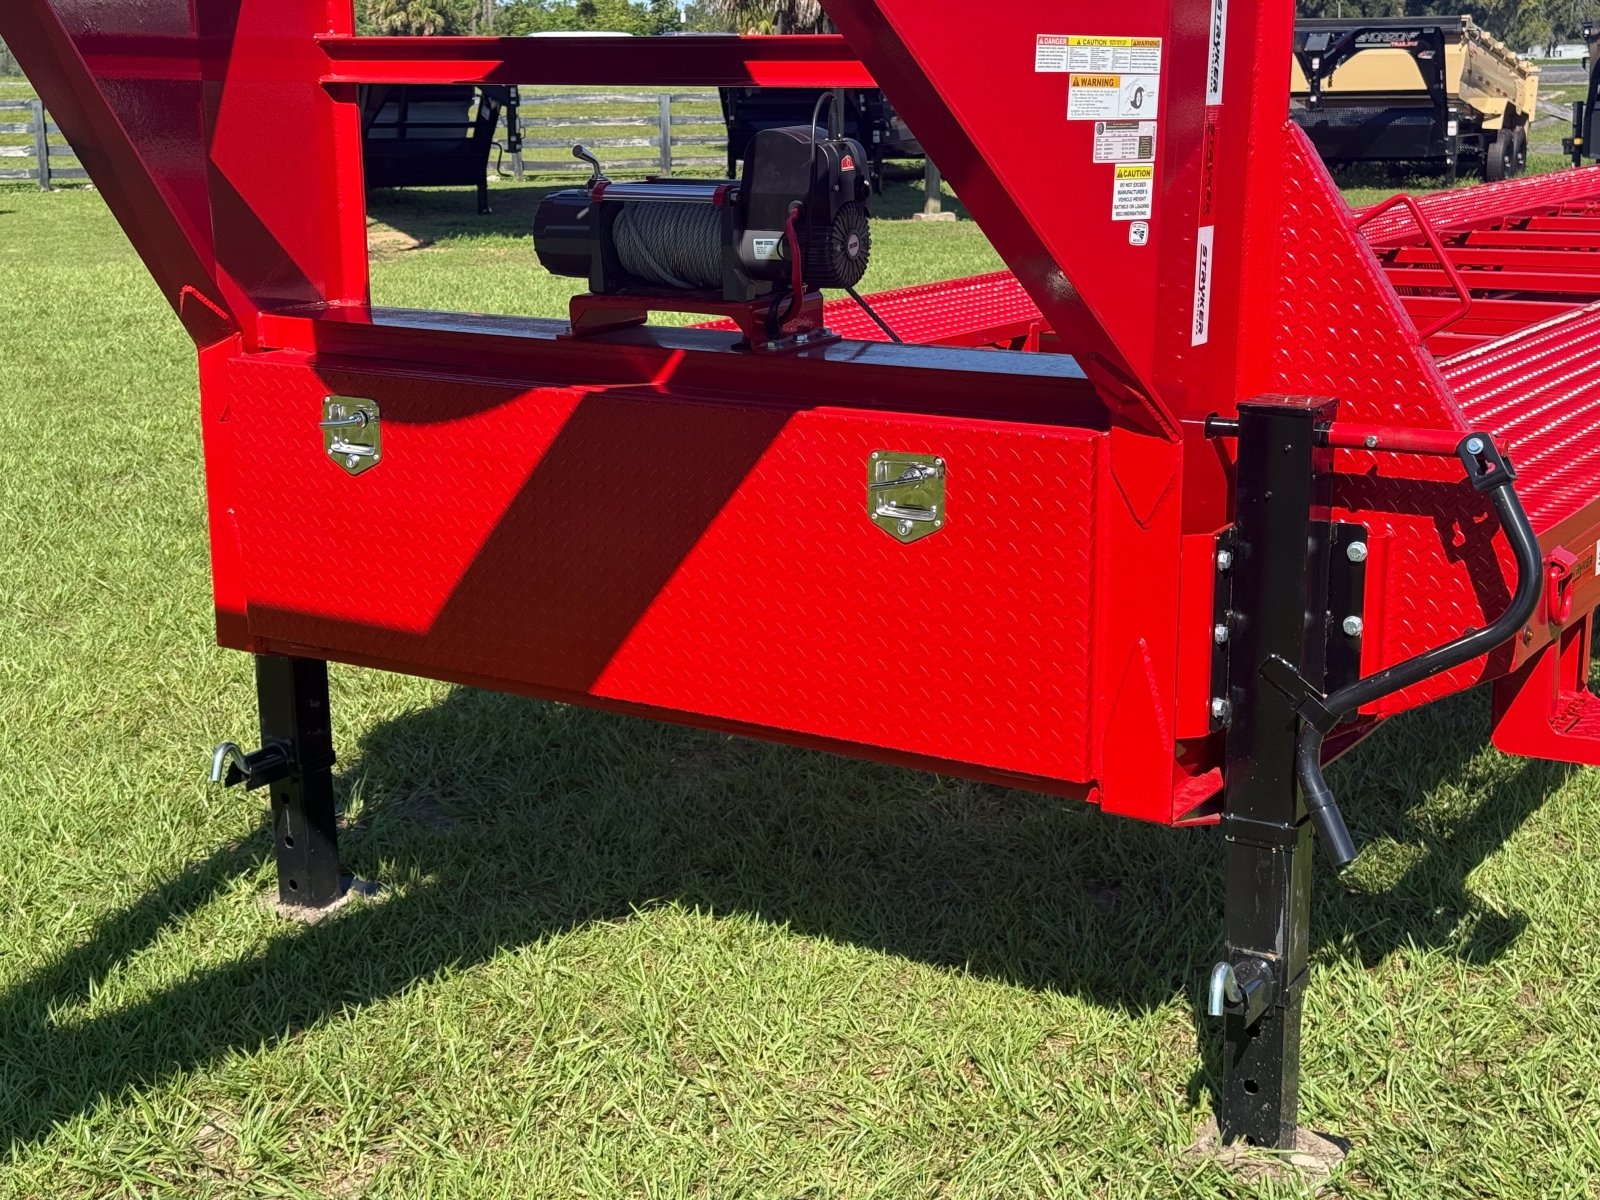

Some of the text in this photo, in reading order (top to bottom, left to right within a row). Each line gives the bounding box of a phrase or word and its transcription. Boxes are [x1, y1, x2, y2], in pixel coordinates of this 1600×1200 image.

[1044, 37, 1067, 45] DANGER
[1081, 78, 1115, 87] WARNING
[1123, 169, 1151, 178] CAUTION
[1198, 244, 1207, 335] STRYKER
